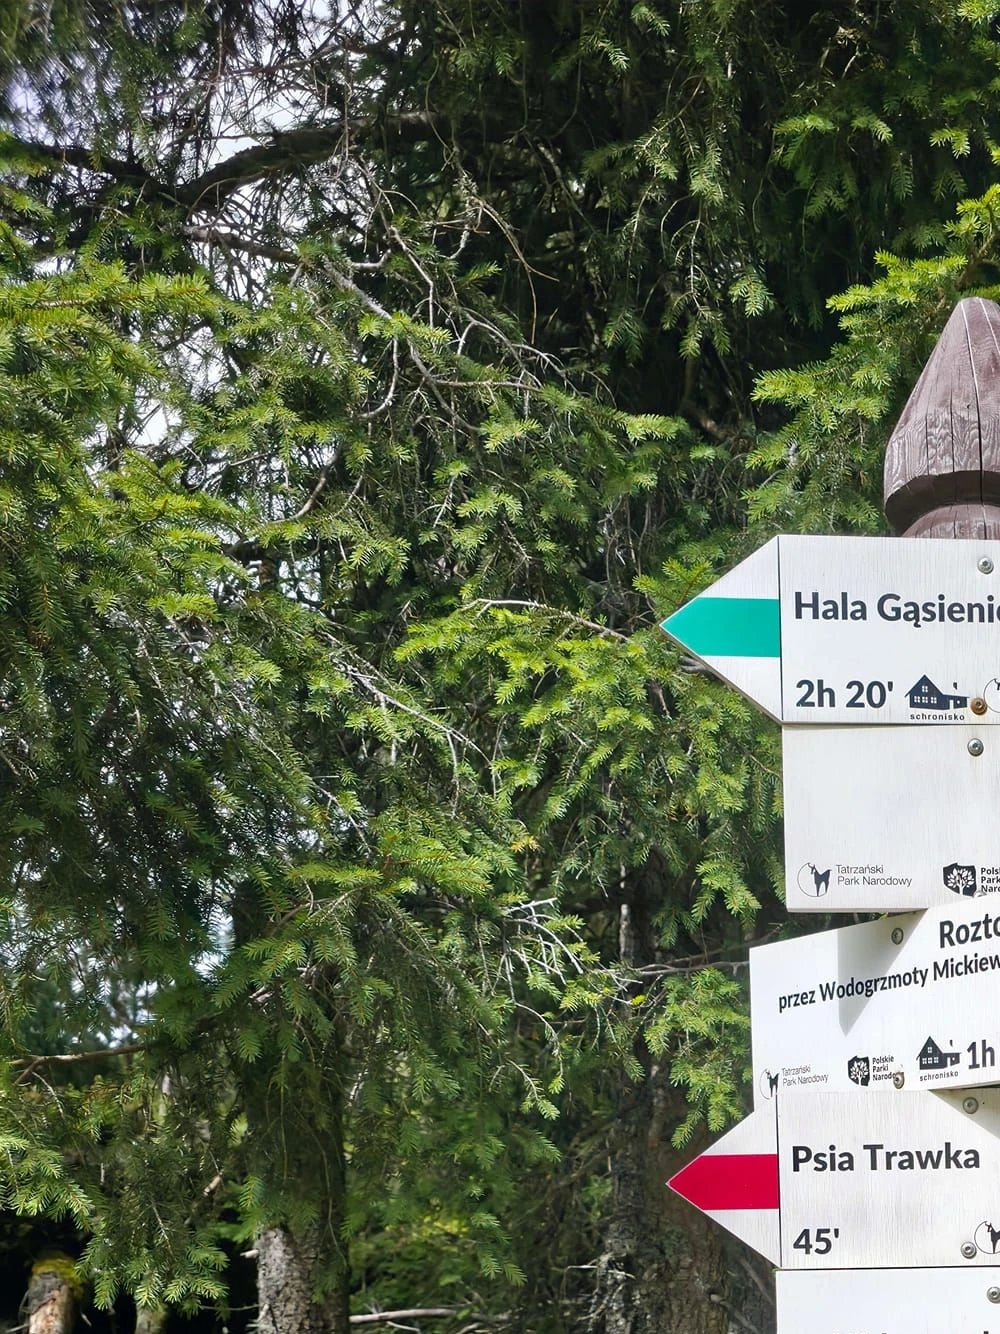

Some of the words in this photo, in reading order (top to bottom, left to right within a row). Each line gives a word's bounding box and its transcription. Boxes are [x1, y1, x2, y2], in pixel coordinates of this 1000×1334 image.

[794, 592, 868, 621] Hala
[796, 680, 836, 708] 2h
[846, 680, 894, 708] 20'
[909, 712, 966, 721] schronisko
[836, 864, 884, 875] Tatrzański
[837, 876, 860, 886] Park
[862, 876, 913, 889] Narodowy
[778, 989, 816, 1013] przez
[819, 966, 929, 1002] Wodogrzmoty
[872, 1056, 895, 1065] Polskie
[967, 1039, 996, 1069] 1h
[782, 1064, 811, 1076] Tatrzański
[872, 1064, 889, 1073] Parki
[783, 1078, 797, 1087] Park
[798, 1074, 829, 1085] Narodowy
[919, 1070, 959, 1082] schronisko
[792, 1145, 855, 1172] Psia
[863, 1142, 981, 1170] Trawka
[793, 1228, 840, 1255] 45'
